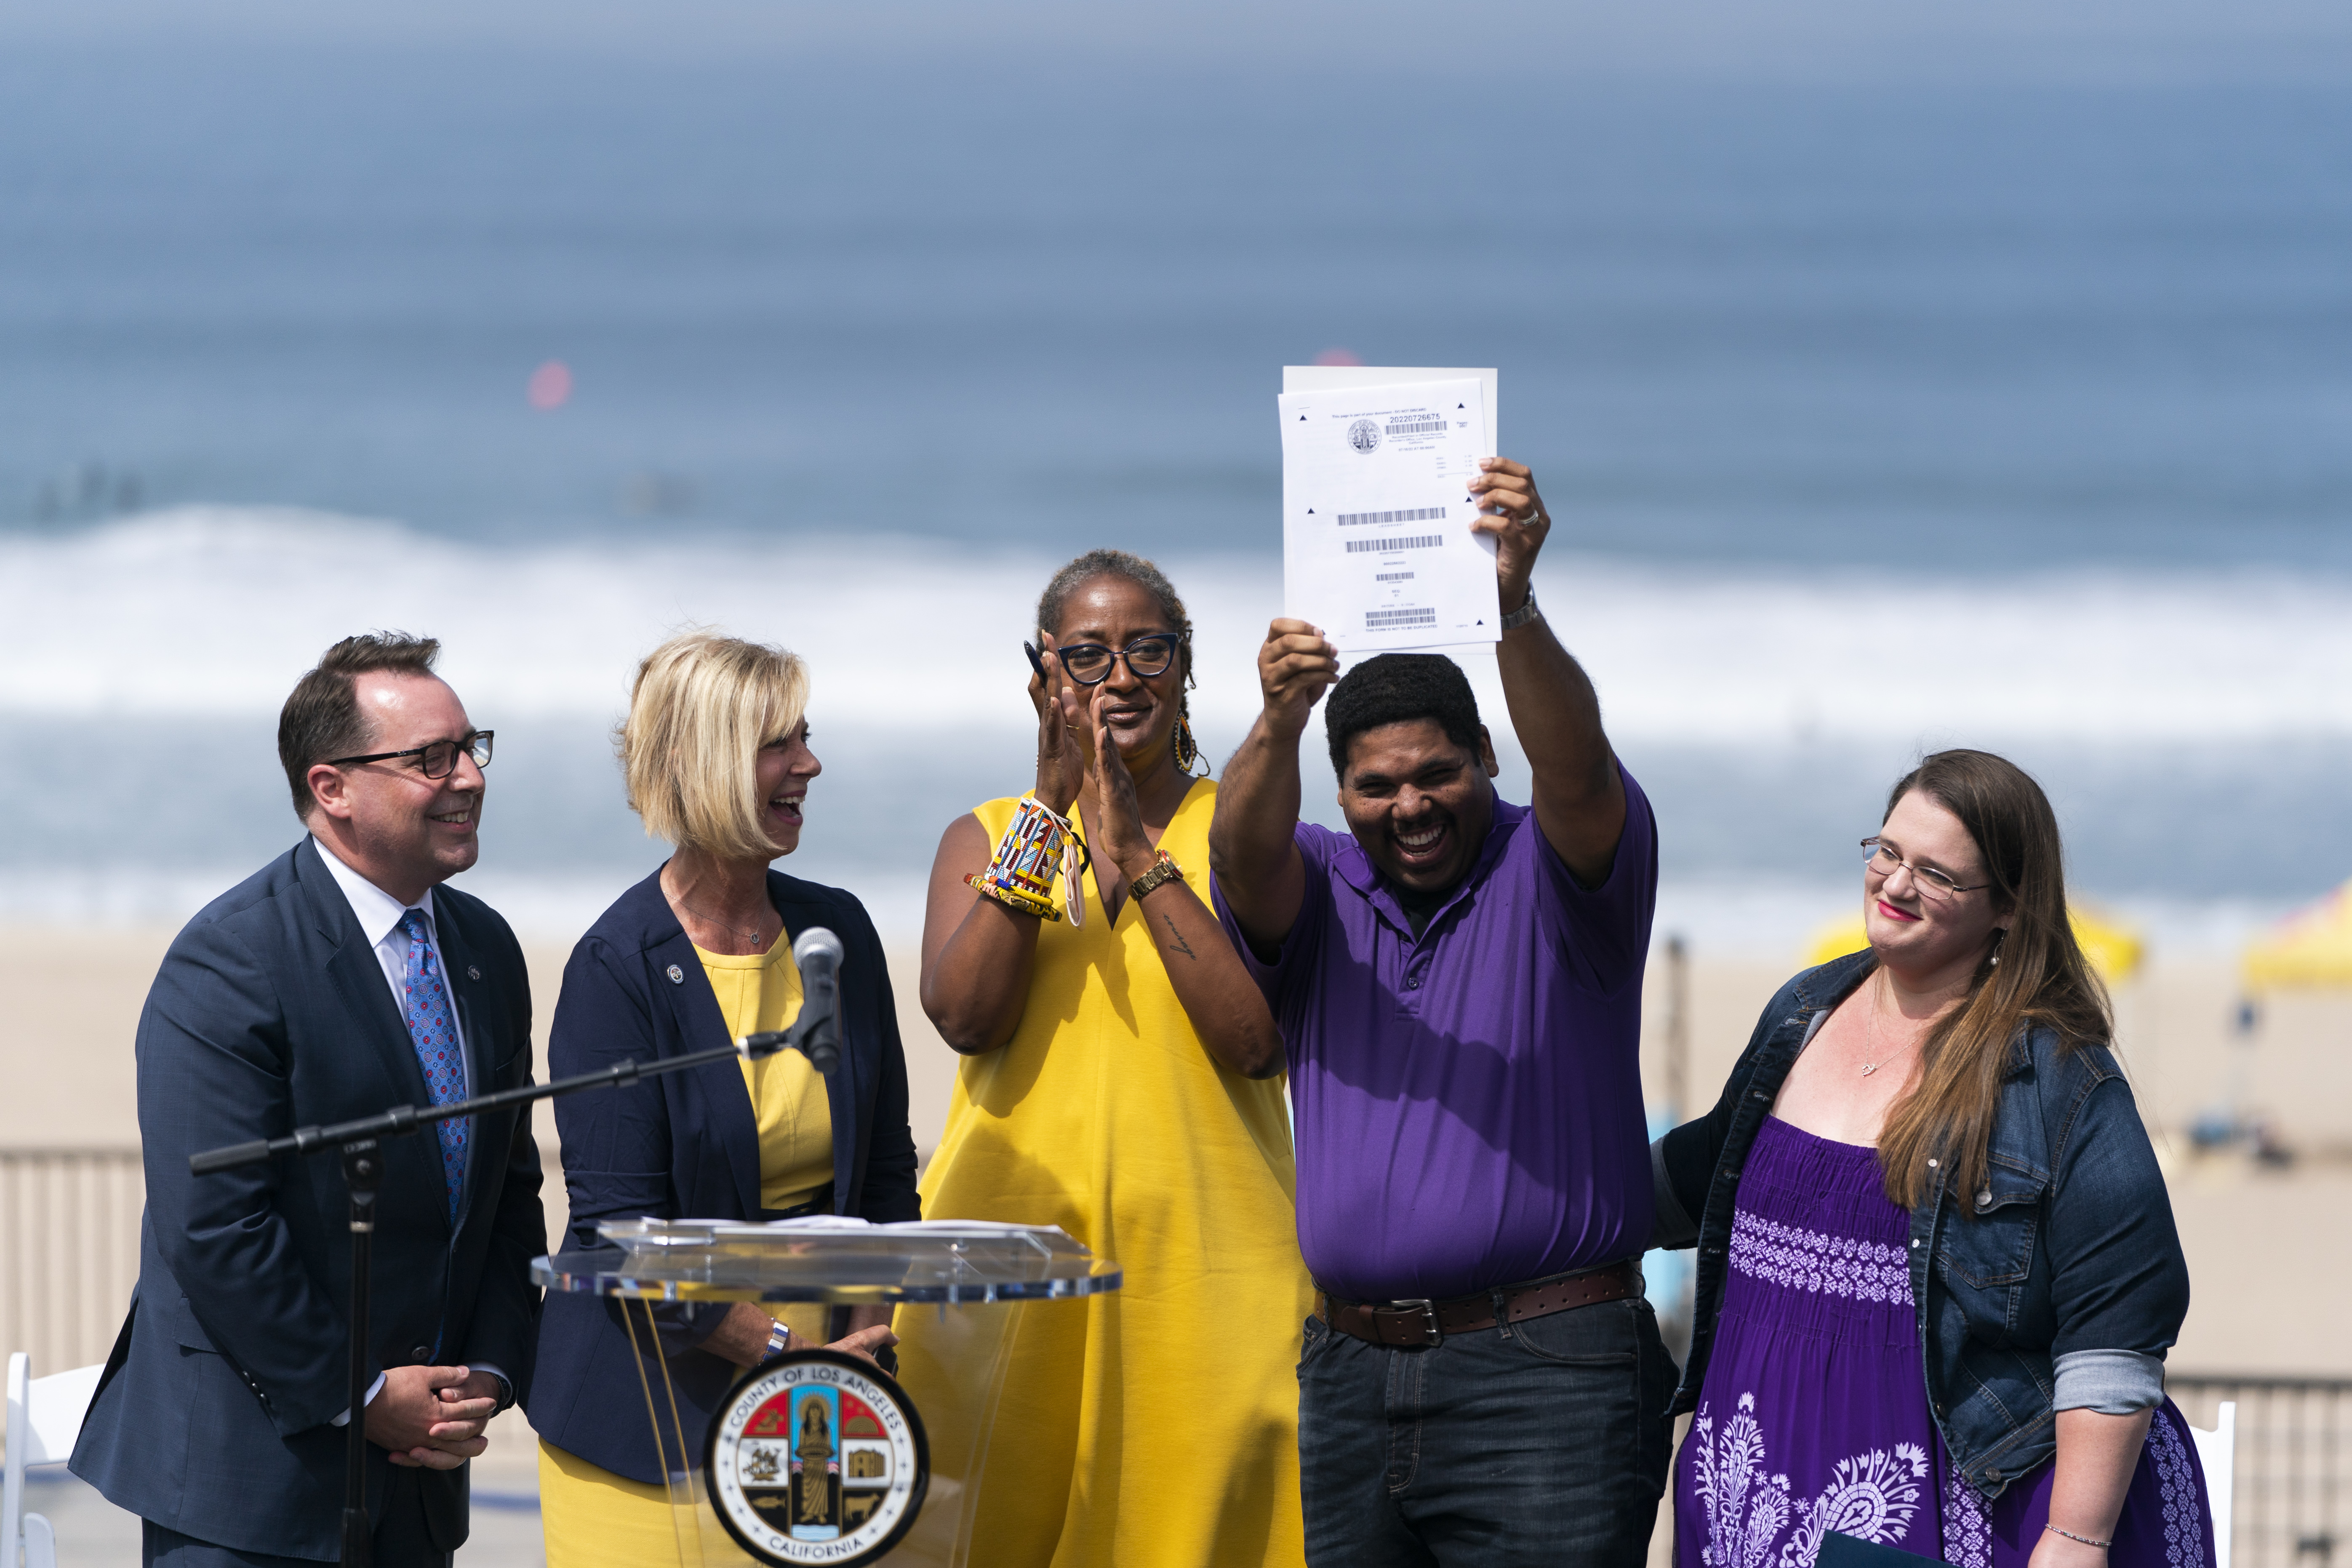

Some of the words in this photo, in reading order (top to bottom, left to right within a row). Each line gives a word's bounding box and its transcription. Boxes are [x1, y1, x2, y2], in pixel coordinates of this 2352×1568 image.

[1390, 413, 1440, 423] 20220726675
[1162, 912, 1197, 961] courage
[731, 1376, 778, 1428] COUNTY
[784, 1368, 805, 1383] OF
[811, 1367, 840, 1381] LOS
[843, 1372, 902, 1430] ANGELES
[769, 1536, 864, 1559] CALIFORNIA
